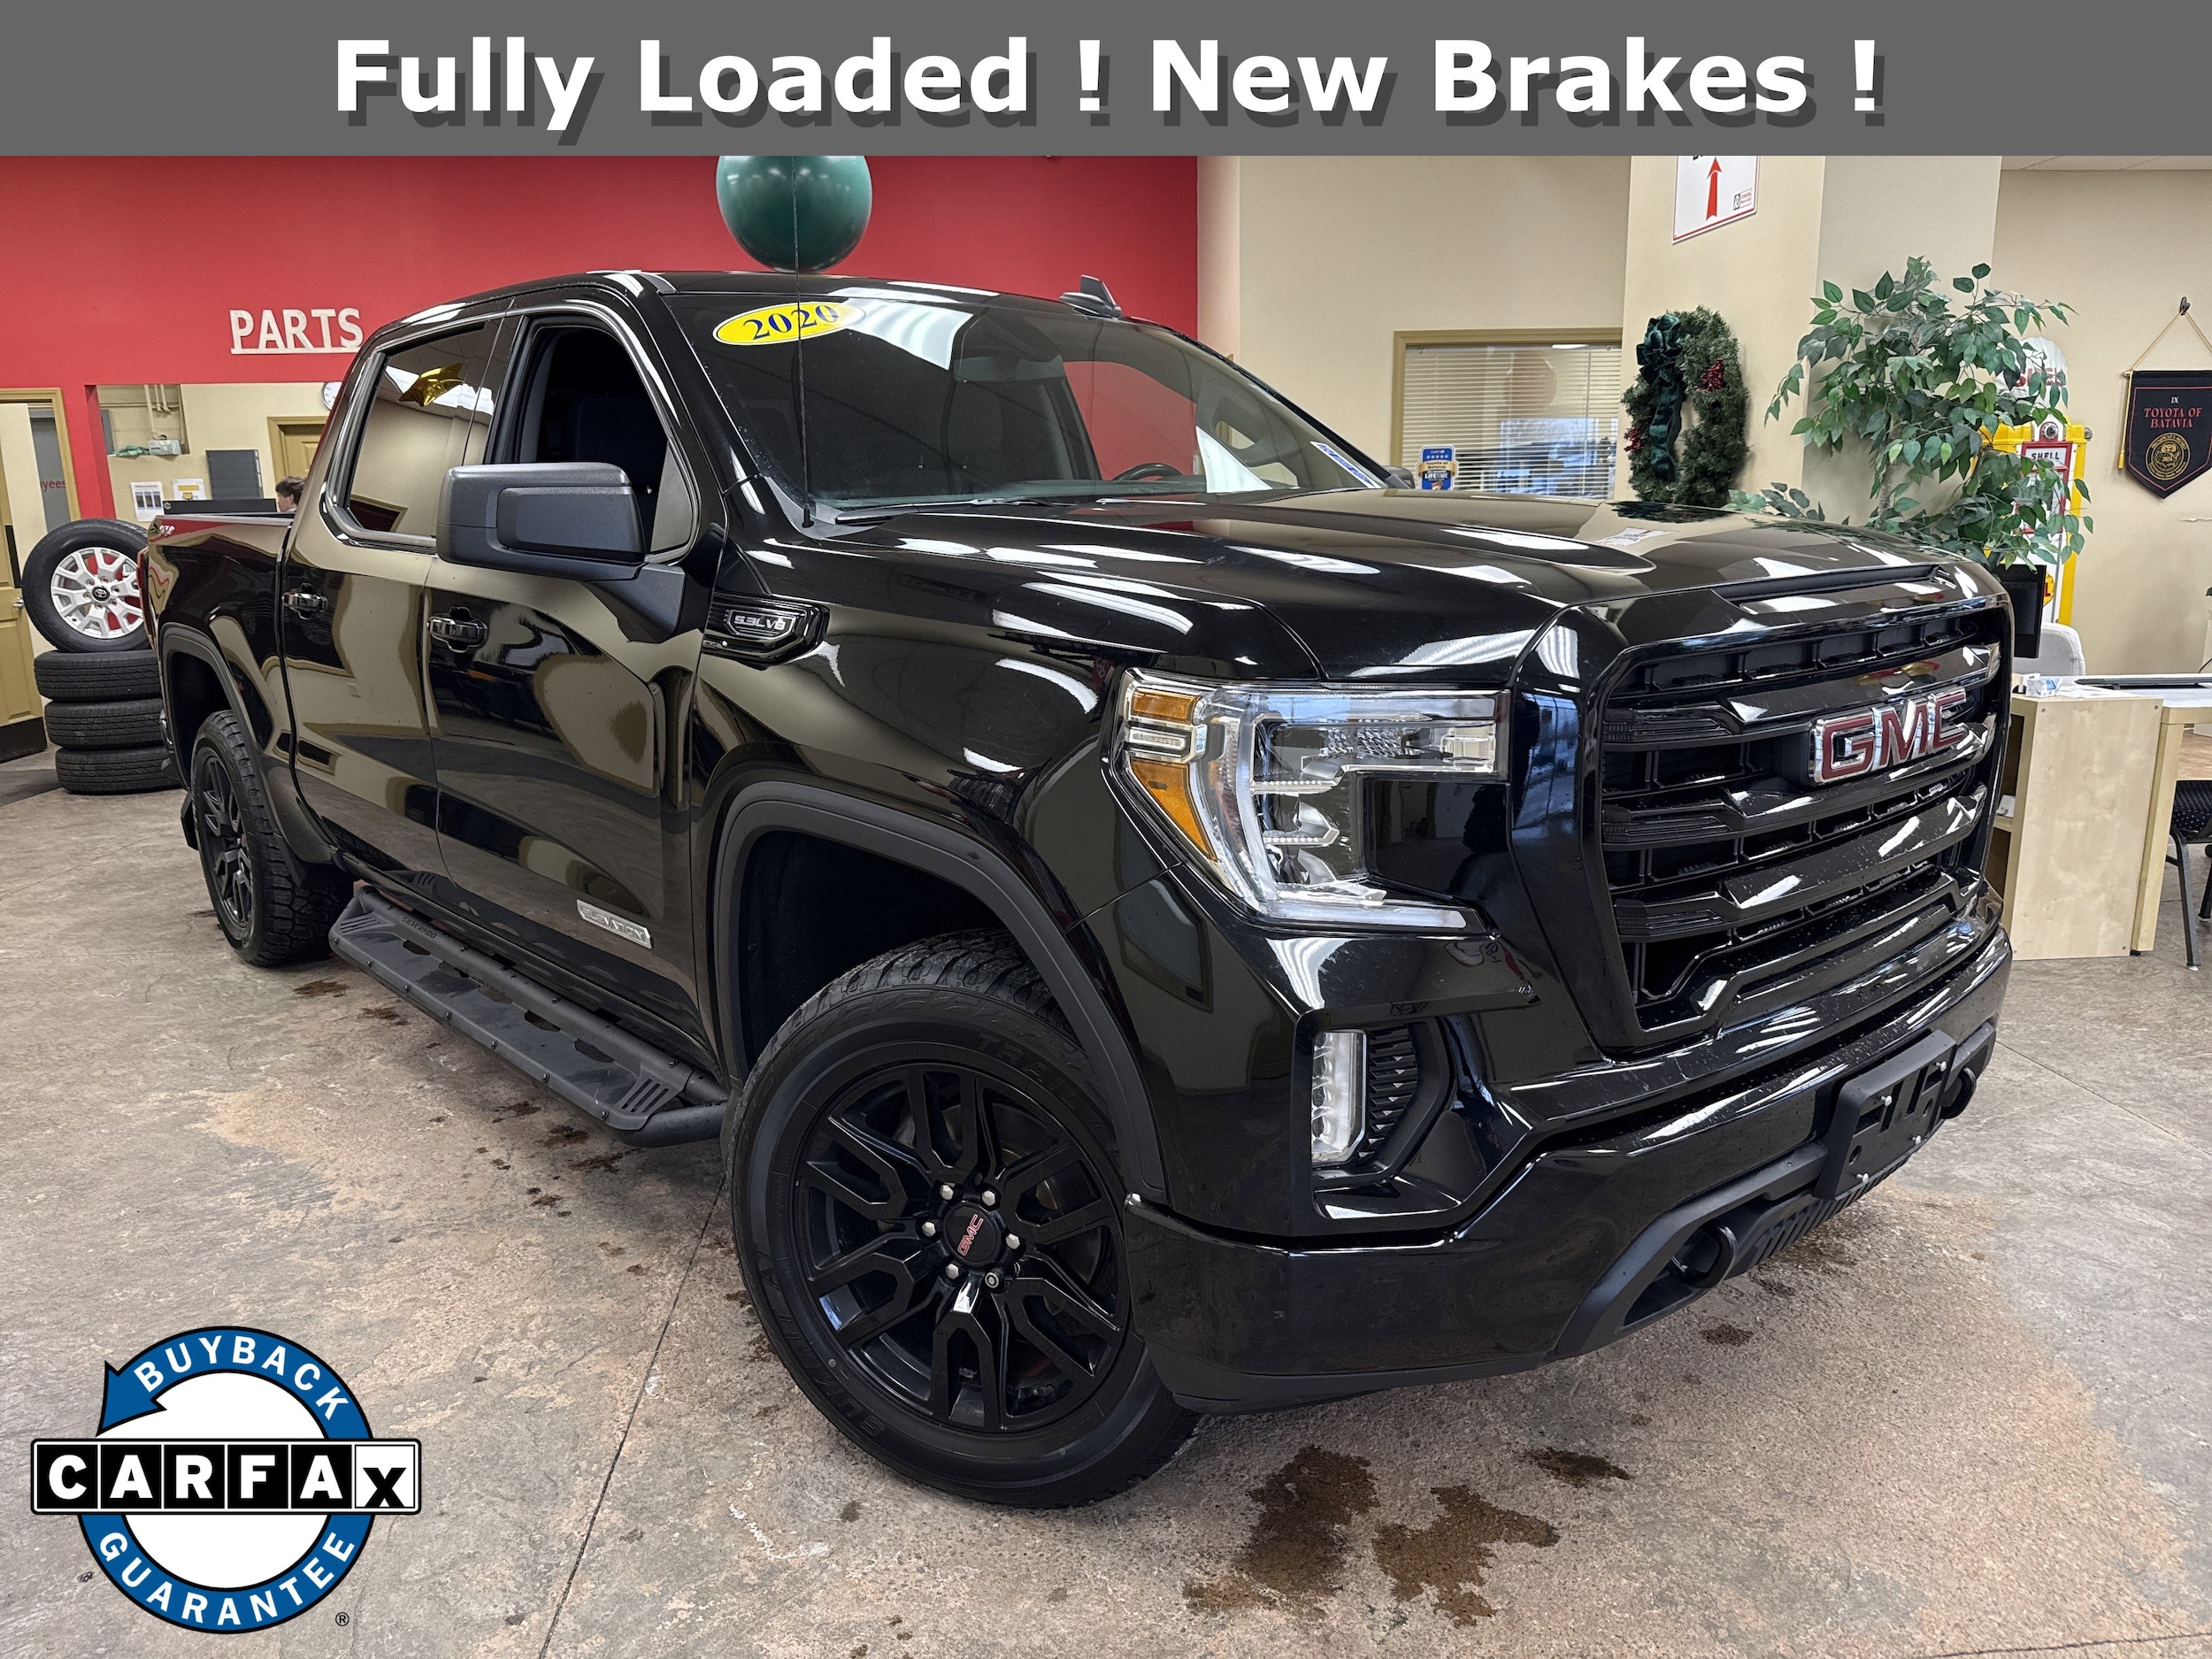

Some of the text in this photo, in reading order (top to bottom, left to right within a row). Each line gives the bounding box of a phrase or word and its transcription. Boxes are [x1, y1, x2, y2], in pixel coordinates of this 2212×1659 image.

[229, 307, 364, 354] PARTS
[743, 304, 839, 341] 2020
[2144, 408, 2202, 418] TOYOTA OF
[2151, 419, 2193, 428] BATAVIA
[2031, 451, 2060, 460] SHELL
[1814, 687, 1968, 783] GMC
[583, 909, 644, 941] ELEVATION
[957, 1213, 984, 1256] GMC
